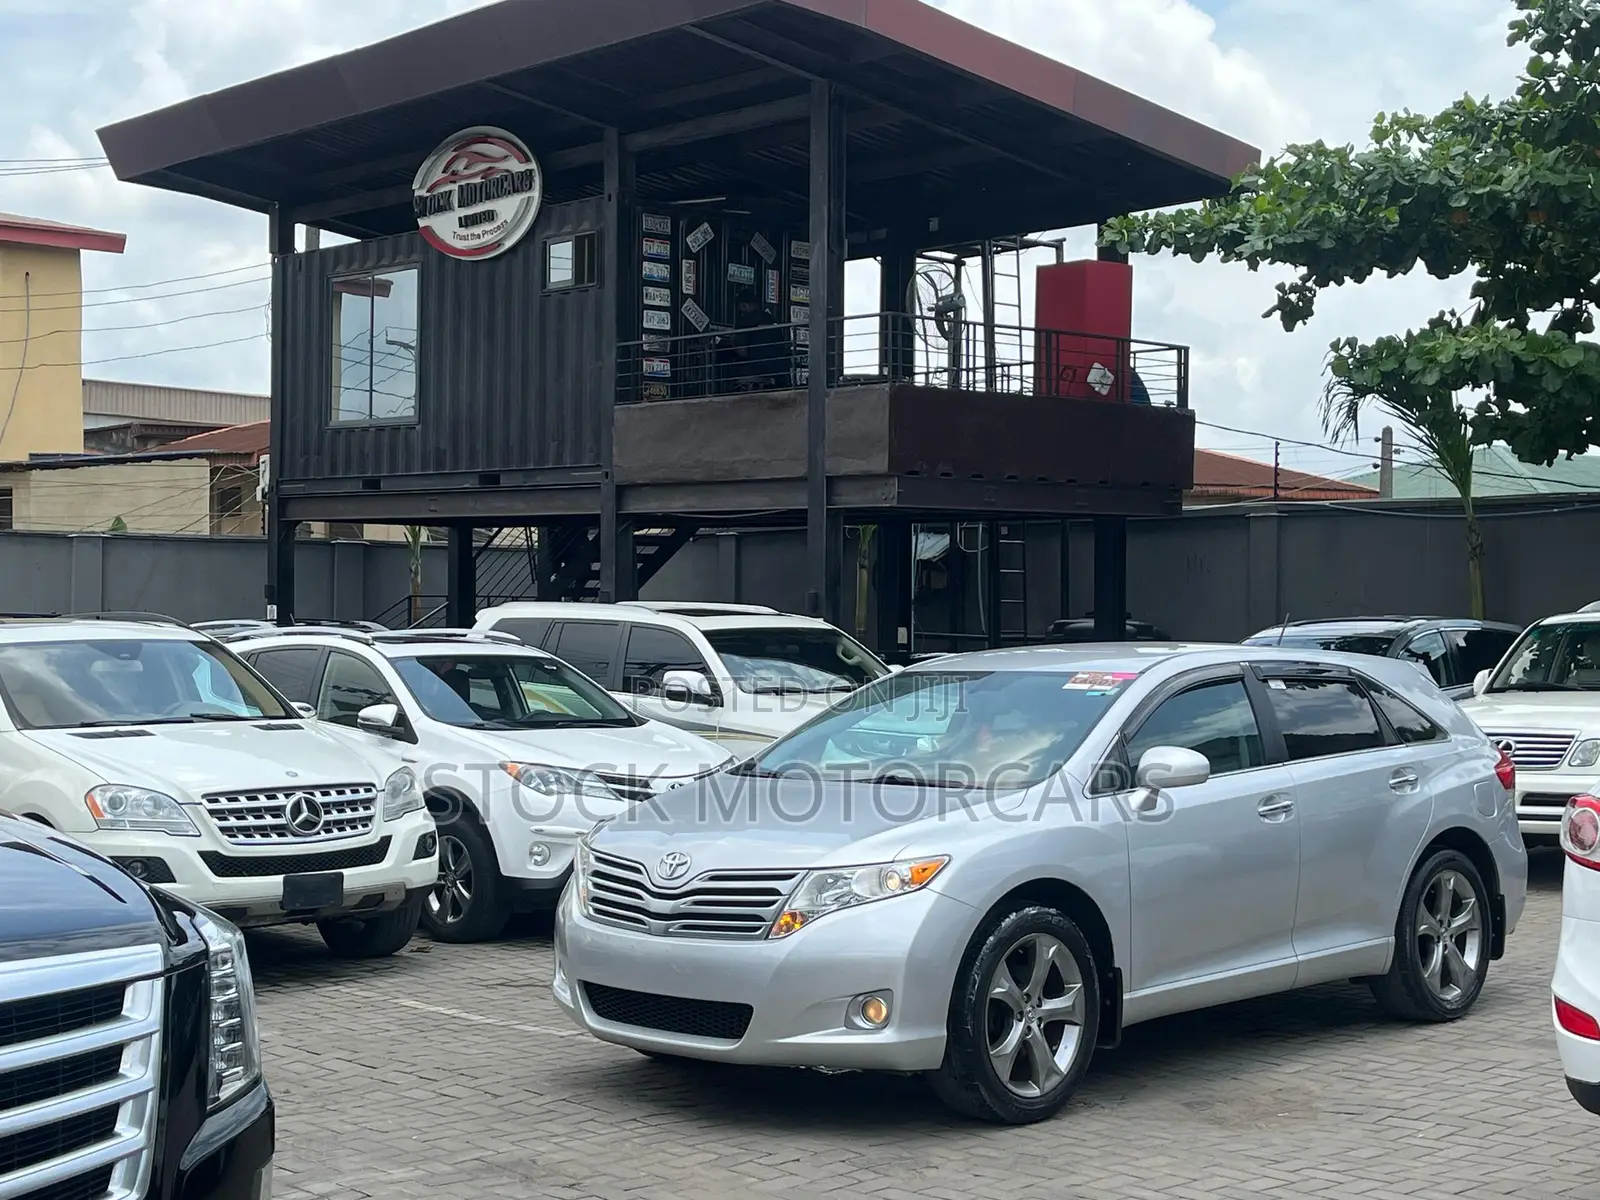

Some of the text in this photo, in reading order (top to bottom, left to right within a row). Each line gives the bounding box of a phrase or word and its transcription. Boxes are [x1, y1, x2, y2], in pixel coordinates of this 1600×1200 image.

[457, 169, 535, 208] MOTORCARS
[452, 219, 509, 242] Trust the Process
